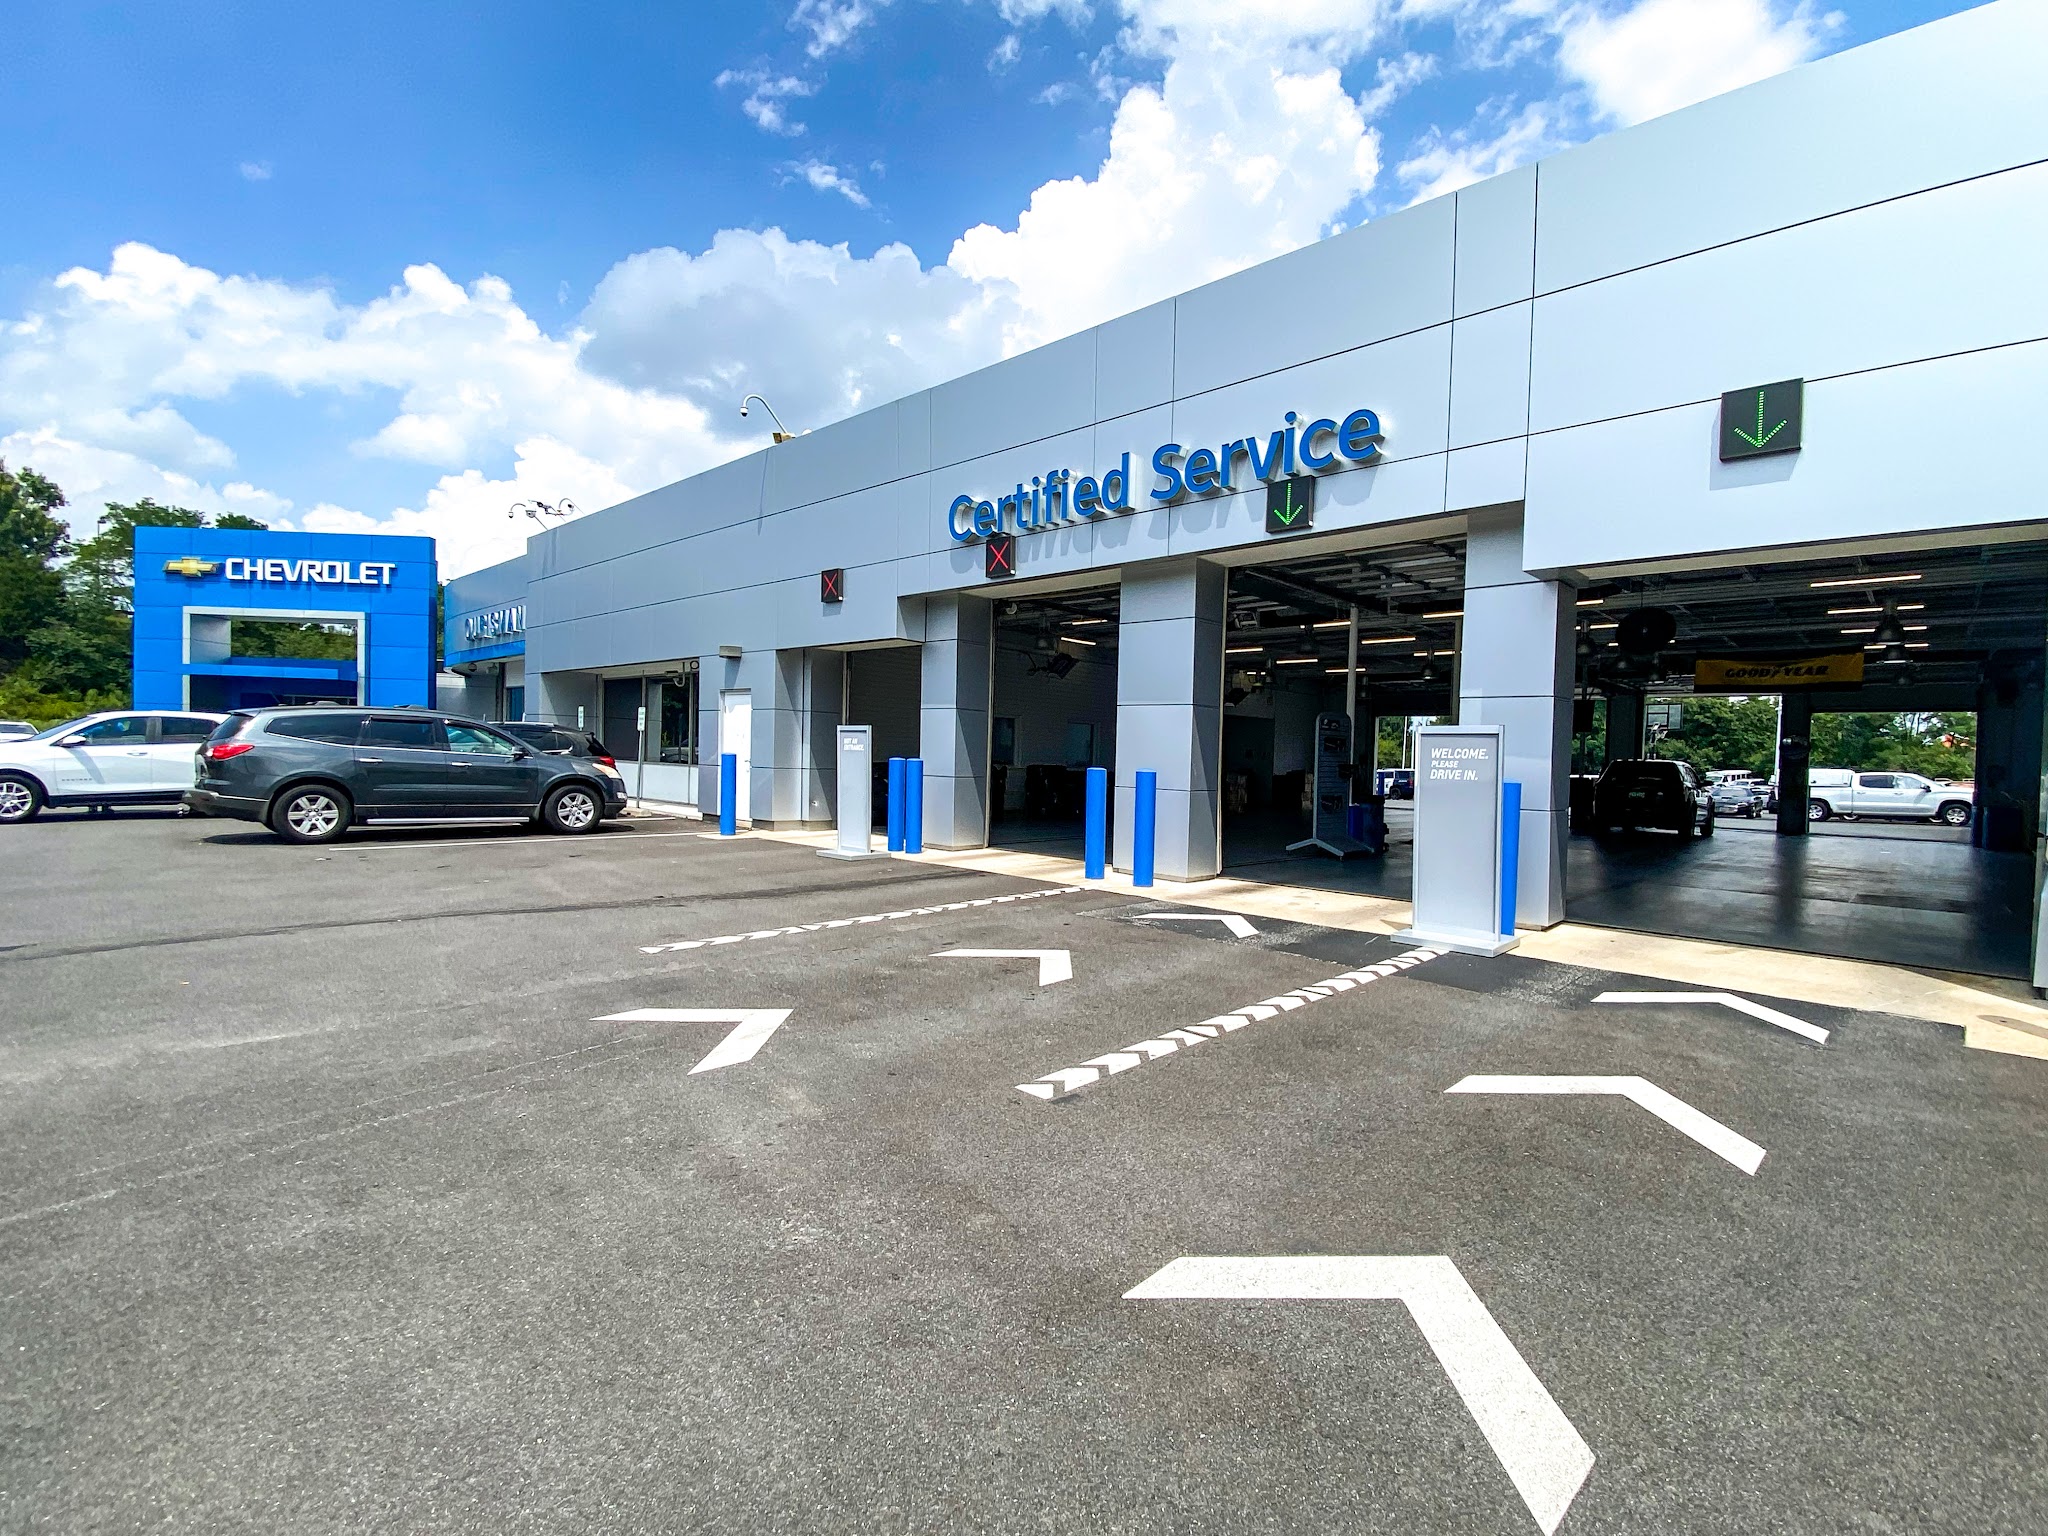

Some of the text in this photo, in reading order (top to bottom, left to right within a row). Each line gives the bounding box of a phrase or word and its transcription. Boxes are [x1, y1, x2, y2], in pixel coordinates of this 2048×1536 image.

[948, 408, 1384, 542] Certified Service
[225, 557, 397, 585] CHEVROLET
[1431, 748, 1489, 759] WELCOME.
[1431, 760, 1459, 768] PLEASE
[1430, 769, 1479, 781] DRIVE IN.
